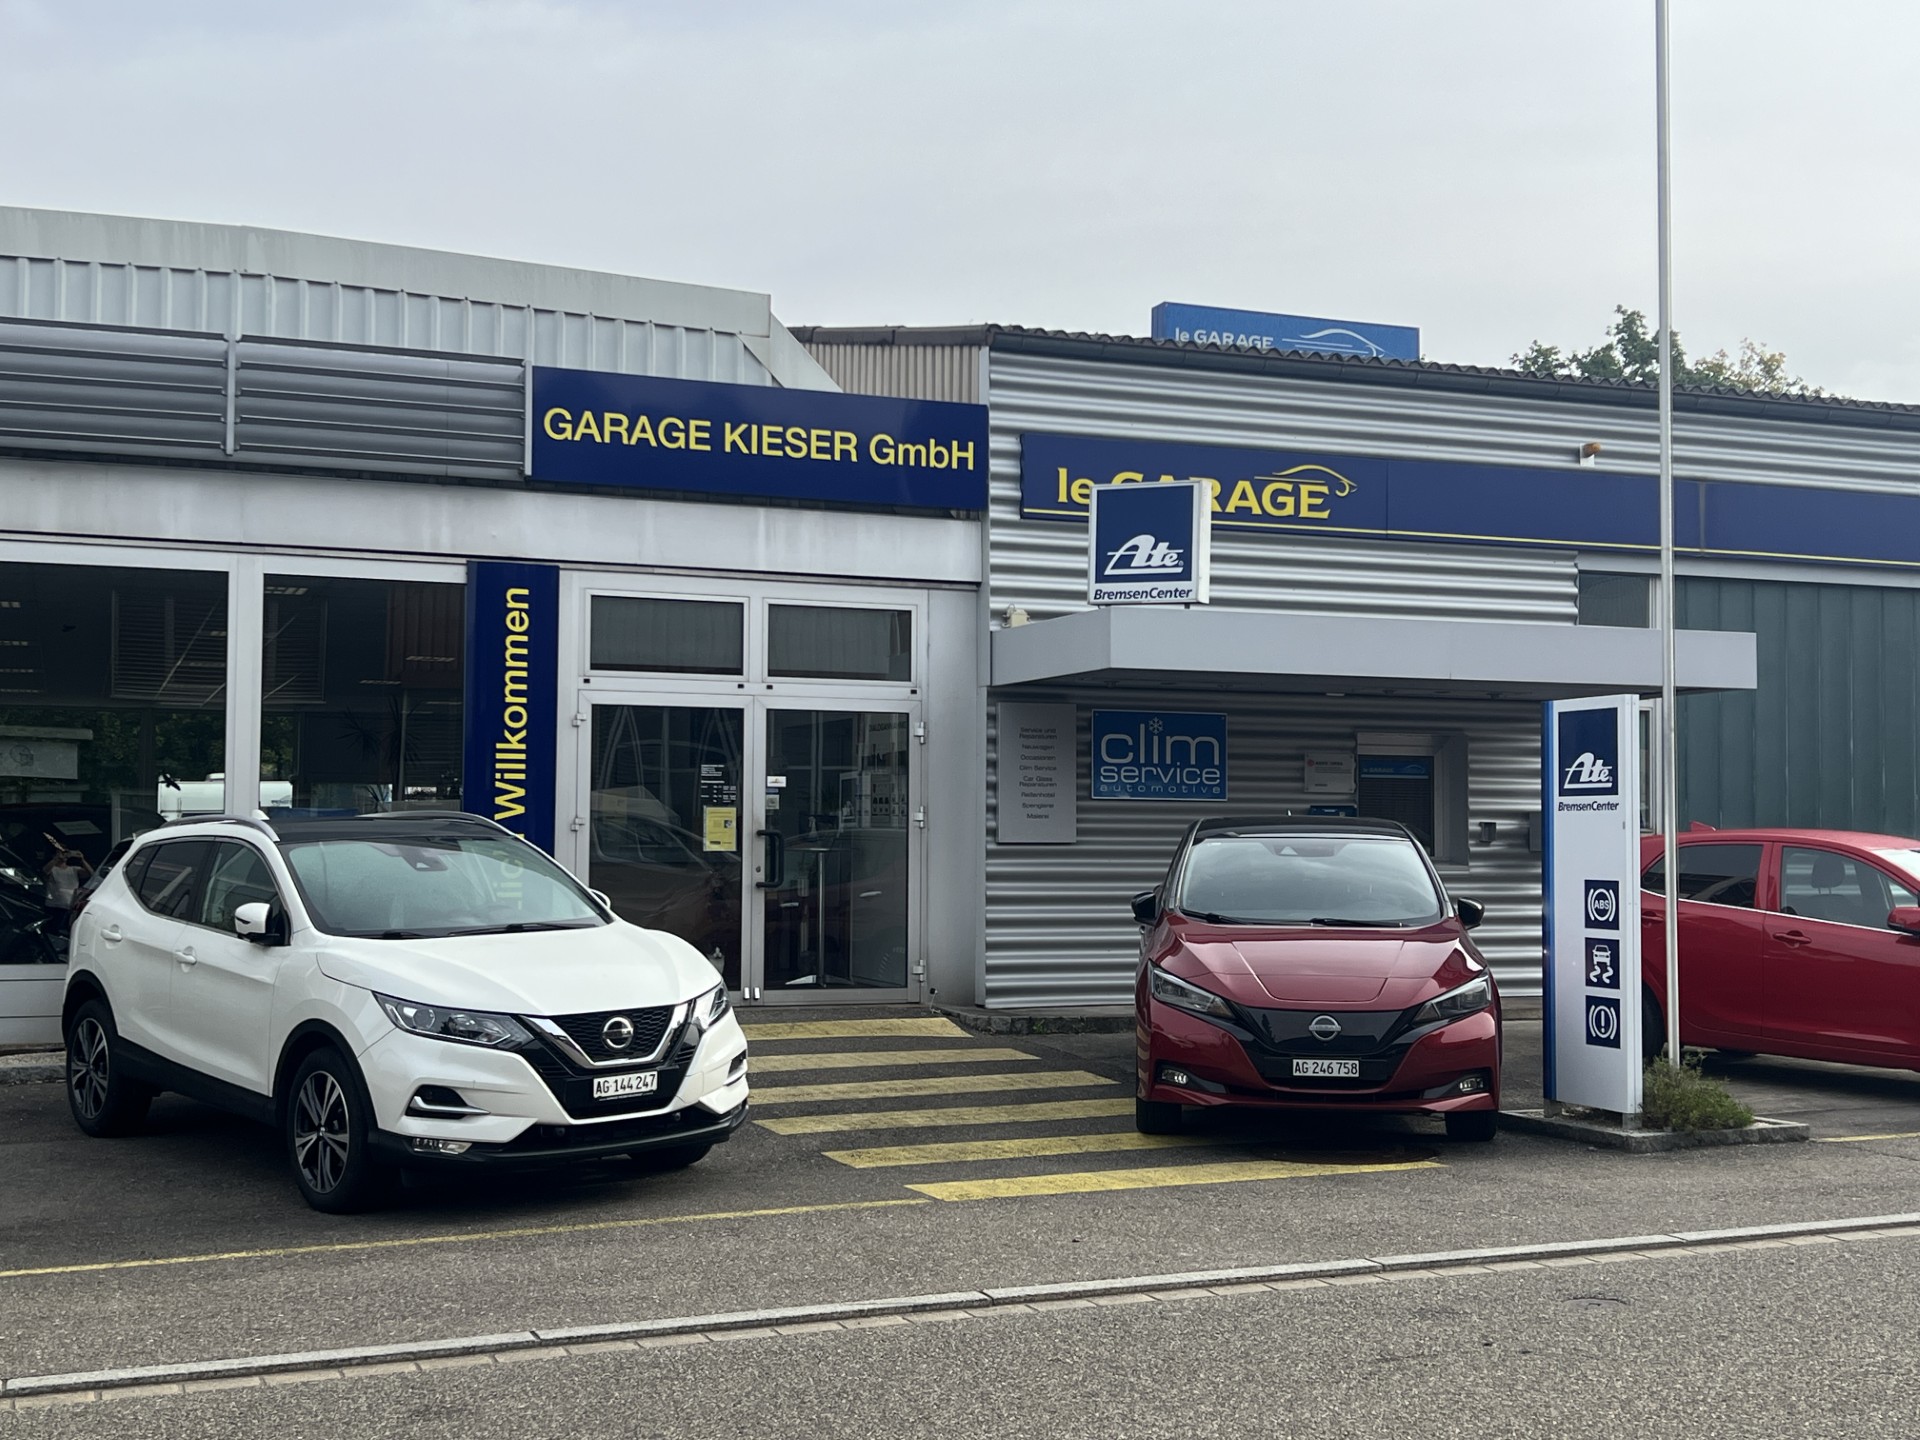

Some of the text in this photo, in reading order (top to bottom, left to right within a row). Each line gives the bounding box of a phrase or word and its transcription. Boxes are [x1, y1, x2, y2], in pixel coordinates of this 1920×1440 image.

[1175, 327, 1274, 350] le GARAGE
[543, 407, 975, 471] GARAGE KIESER GmbH
[1111, 471, 1331, 519] RAGE
[1093, 588, 1193, 601] BremsenCenter
[494, 587, 530, 821] Willkommen
[1100, 723, 1220, 765] clim
[1100, 761, 1220, 785] service
[1099, 783, 1221, 793] automotive
[1558, 801, 1619, 812] BremsenCenter
[1594, 899, 1610, 910] ABS
[1294, 1061, 1358, 1075] AG 246 758
[595, 1073, 656, 1095] AG 144 247
